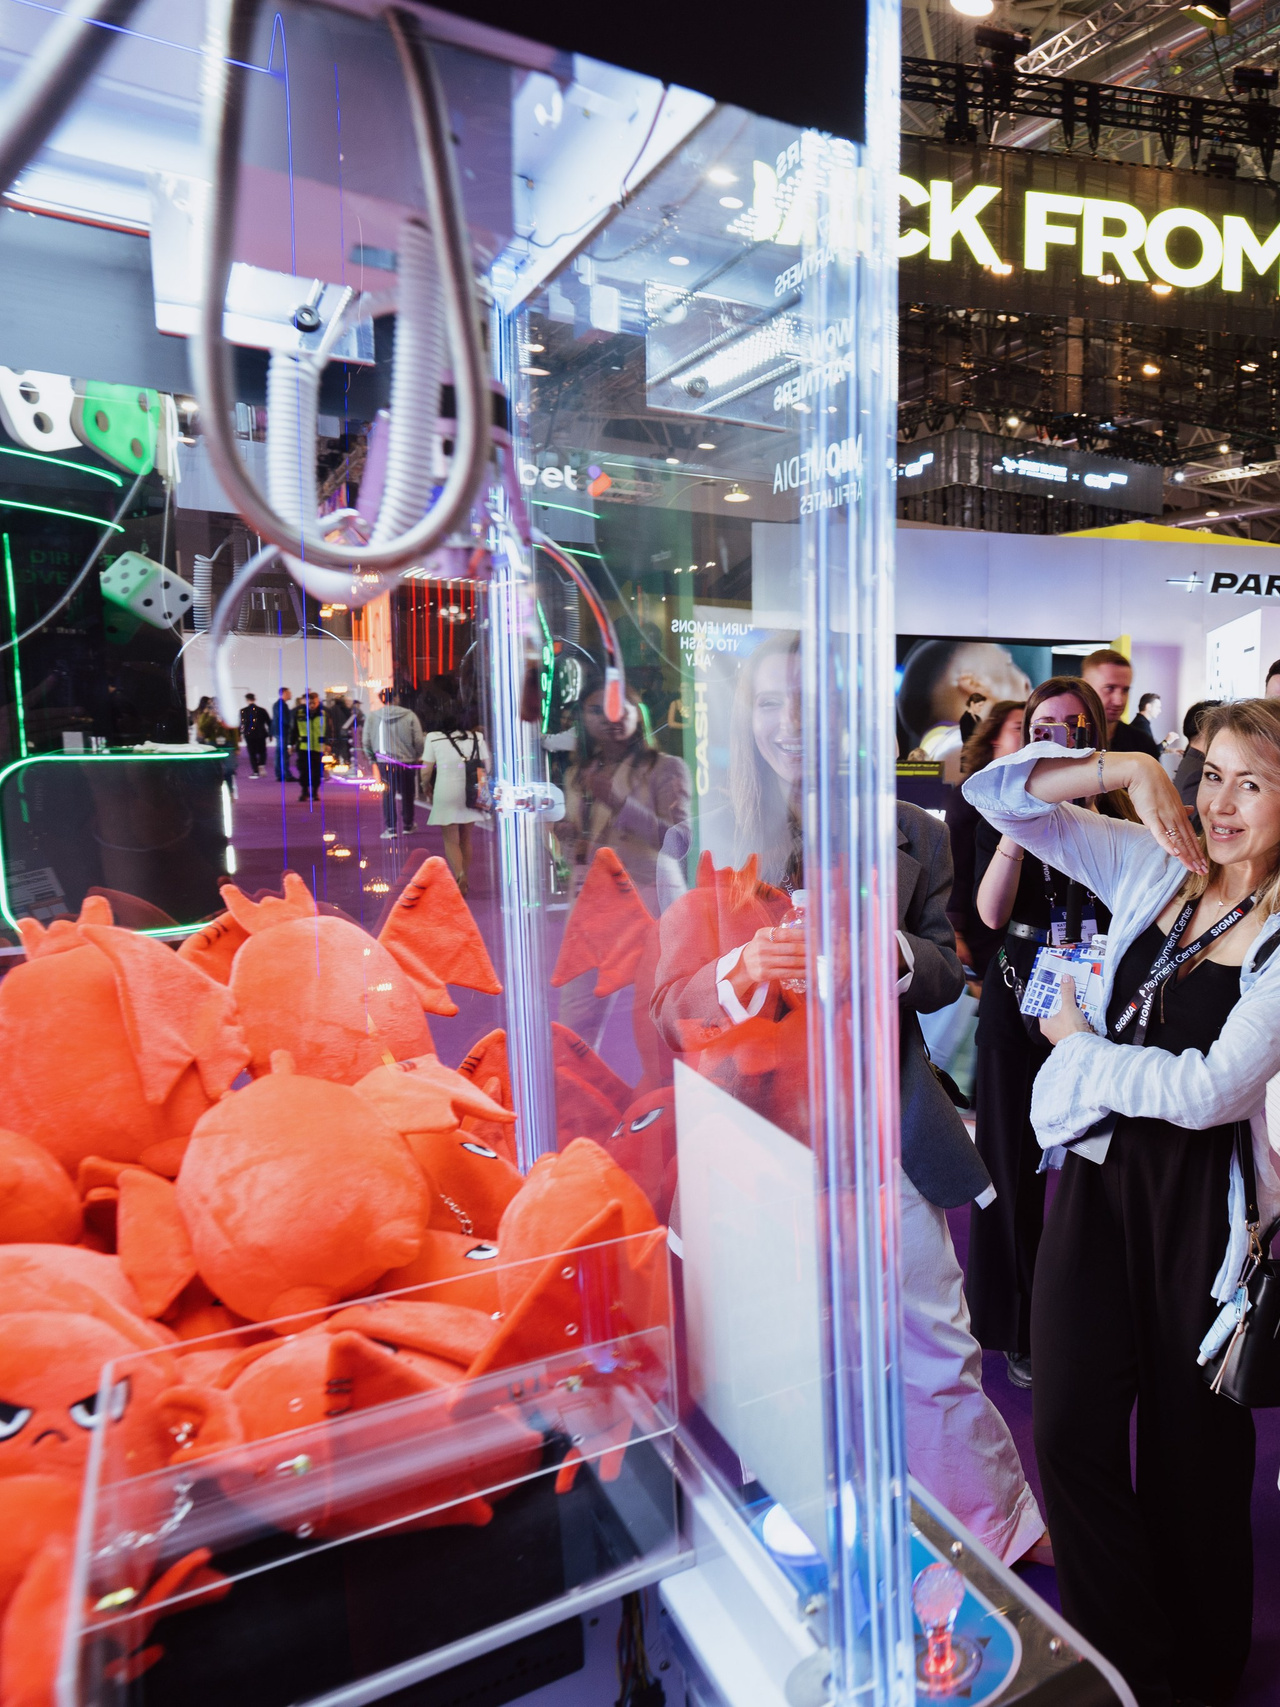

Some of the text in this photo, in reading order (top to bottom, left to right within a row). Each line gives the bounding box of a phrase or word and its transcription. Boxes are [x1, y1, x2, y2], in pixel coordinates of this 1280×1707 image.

[1154, 904, 1194, 969] Payment Center
[1143, 941, 1202, 992] Payment Center
